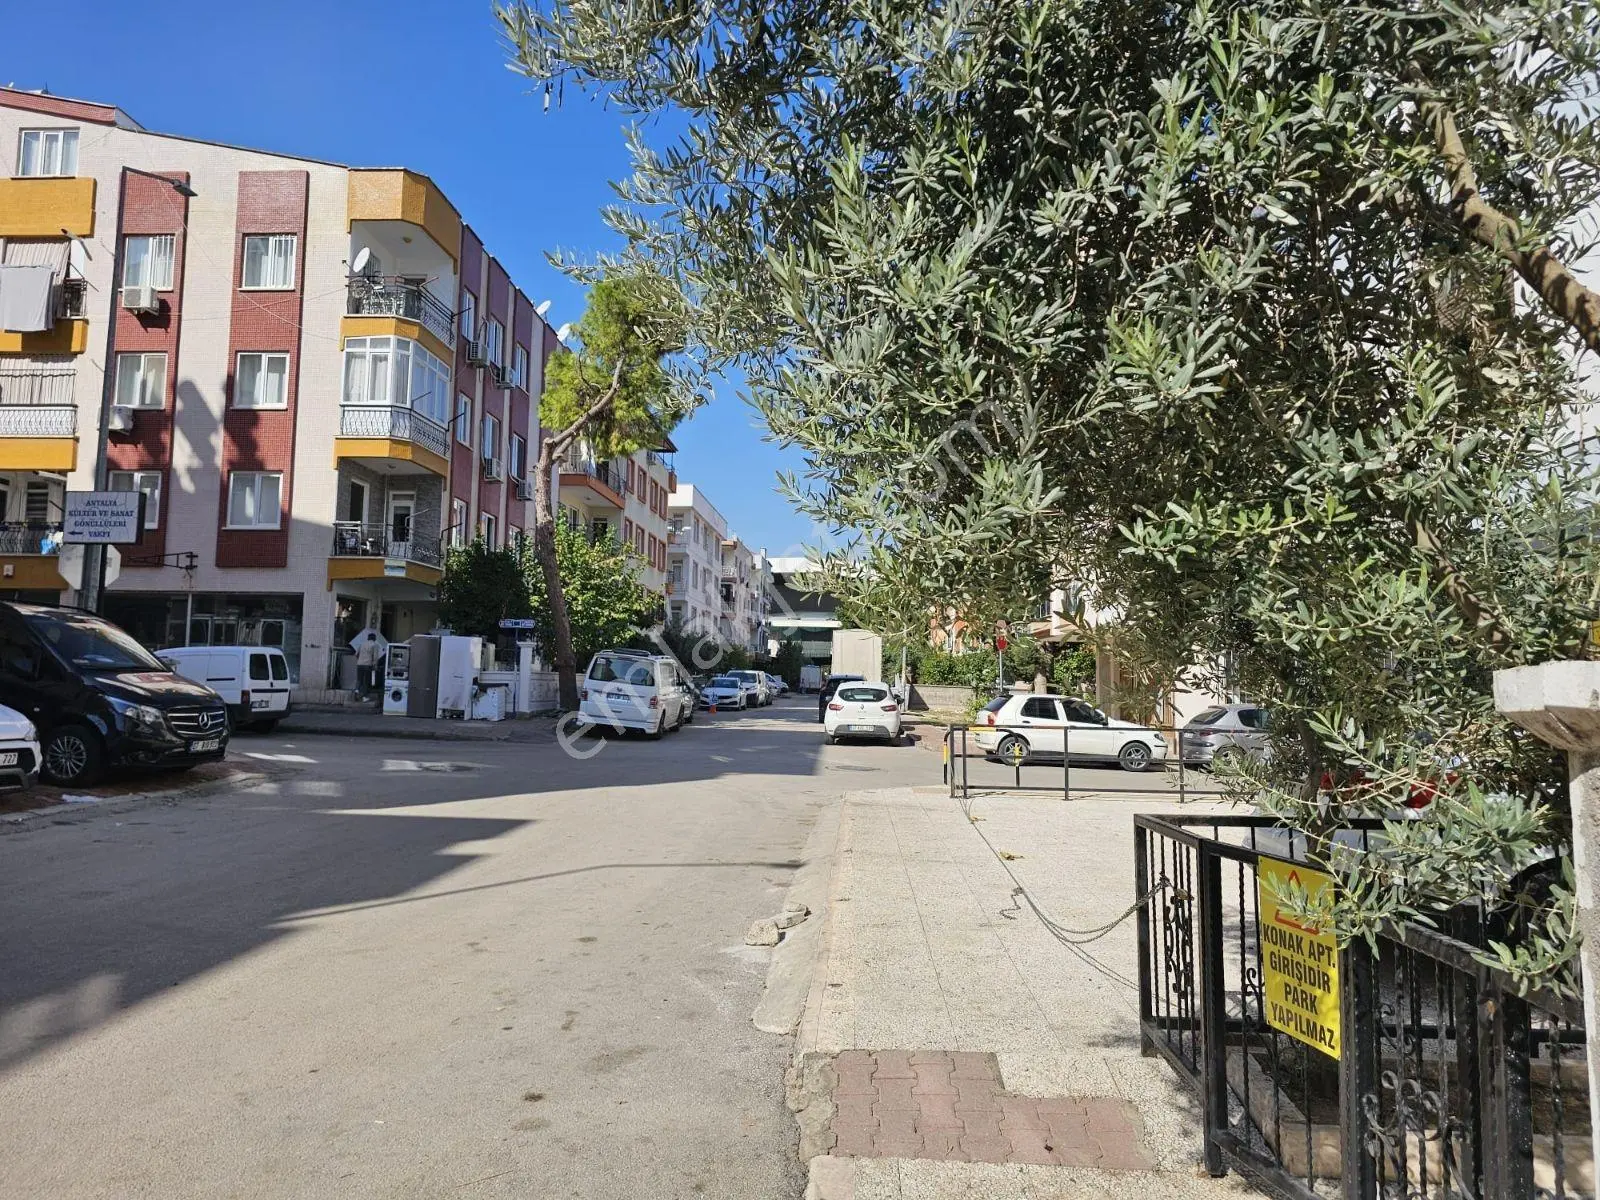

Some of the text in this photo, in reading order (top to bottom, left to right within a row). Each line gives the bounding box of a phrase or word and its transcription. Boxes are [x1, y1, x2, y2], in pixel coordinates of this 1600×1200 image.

[1263, 923, 1335, 968] KONAK APT.
[1269, 949, 1331, 993] GİRİŞİDİR
[1284, 982, 1319, 1016] PARK
[1271, 1002, 1335, 1050] YAPILMAZ
